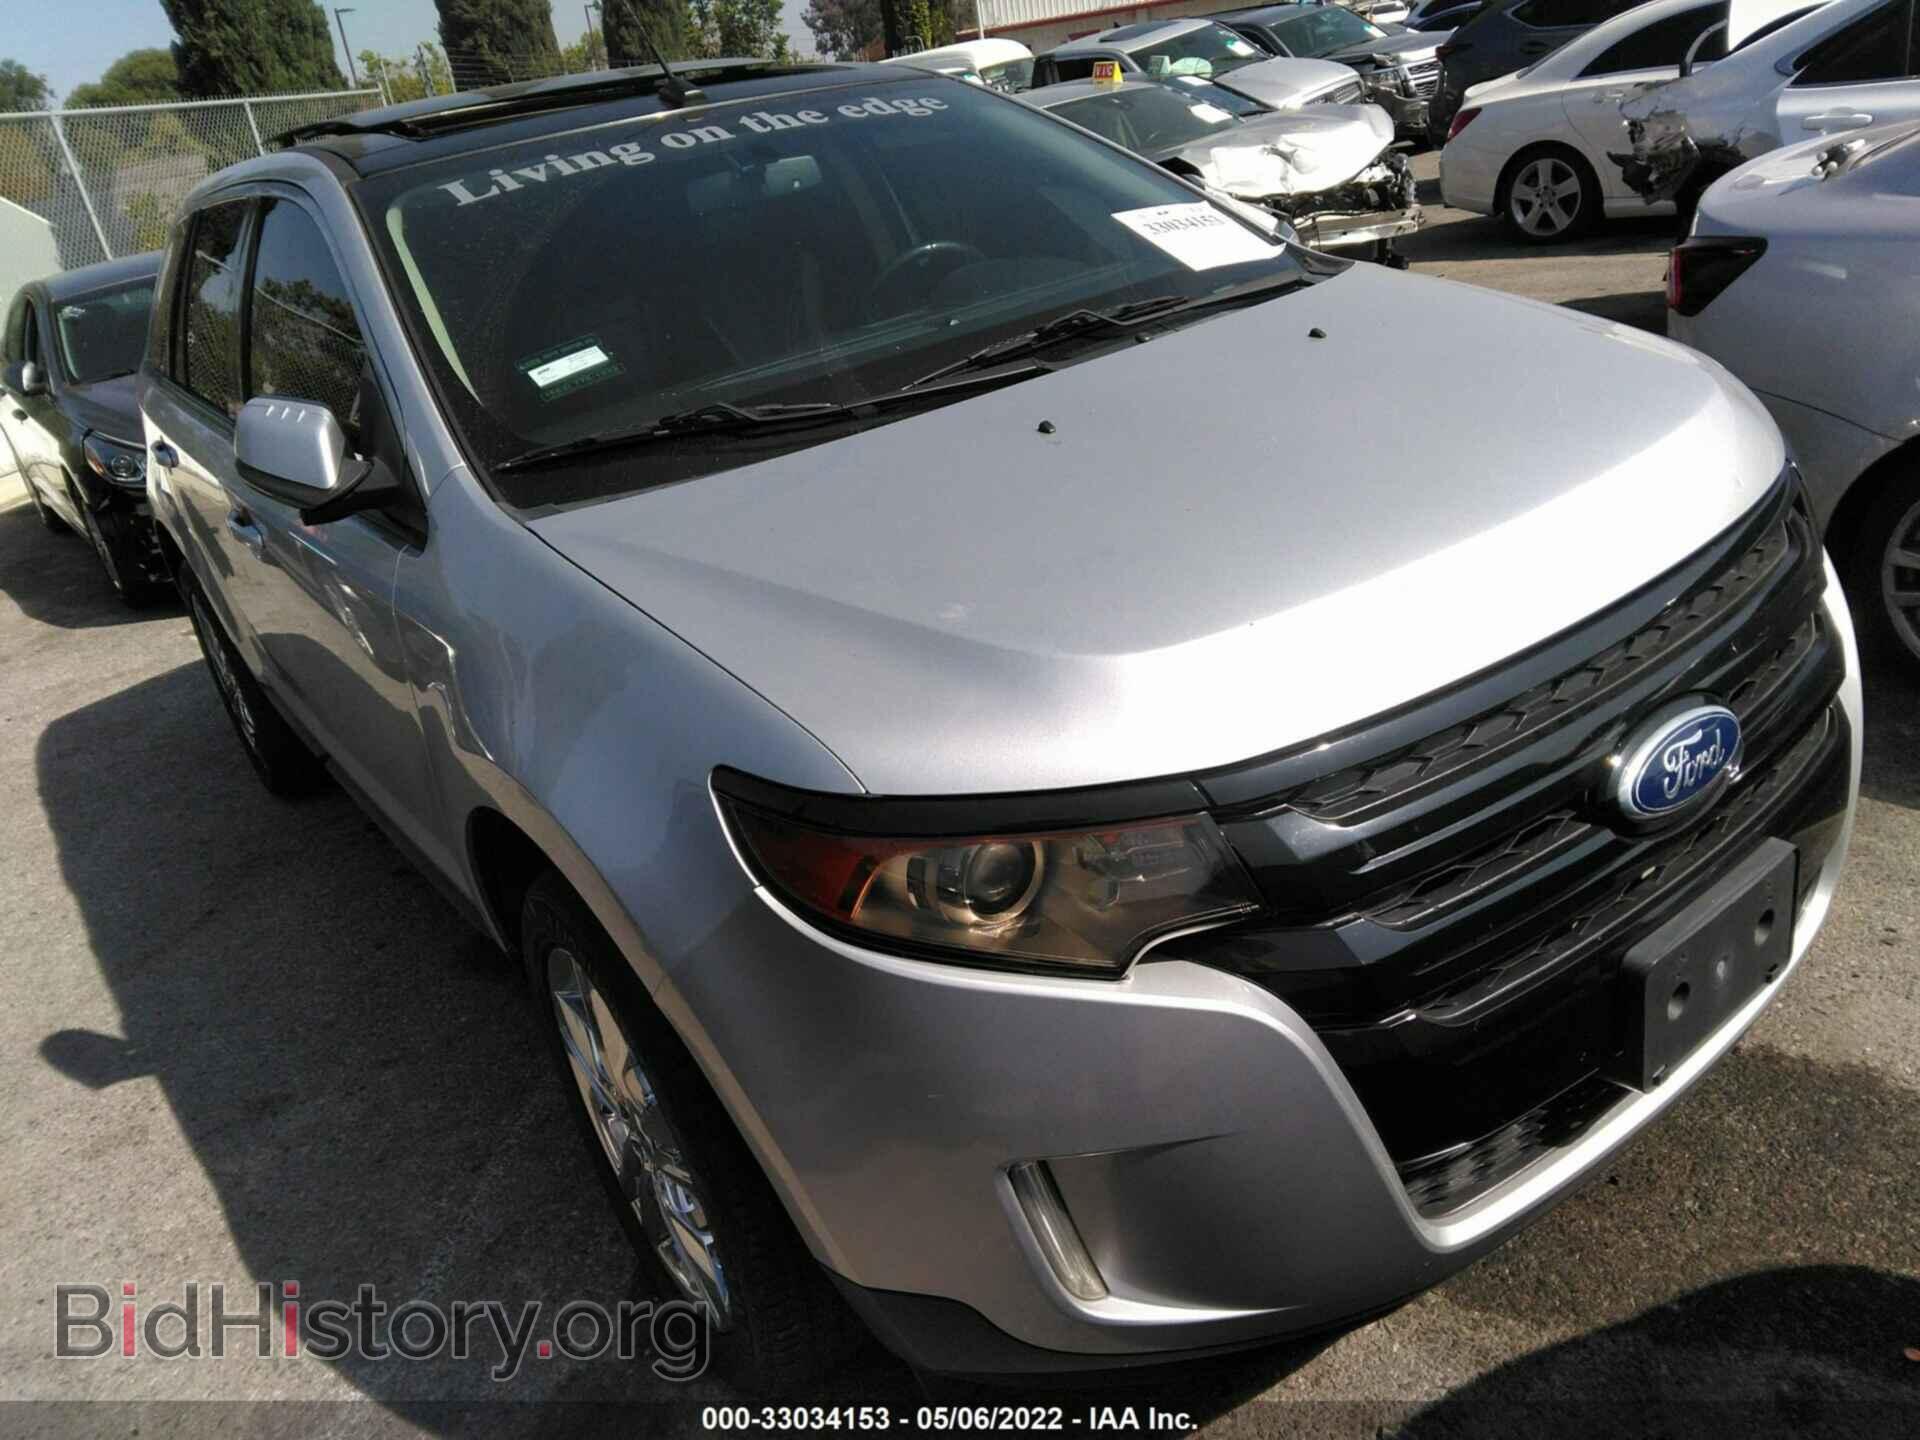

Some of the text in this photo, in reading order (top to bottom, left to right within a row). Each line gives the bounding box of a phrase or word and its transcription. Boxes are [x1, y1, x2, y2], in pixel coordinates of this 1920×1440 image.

[437, 95, 949, 207] Living on the edge
[1663, 728, 1726, 800] Ford
